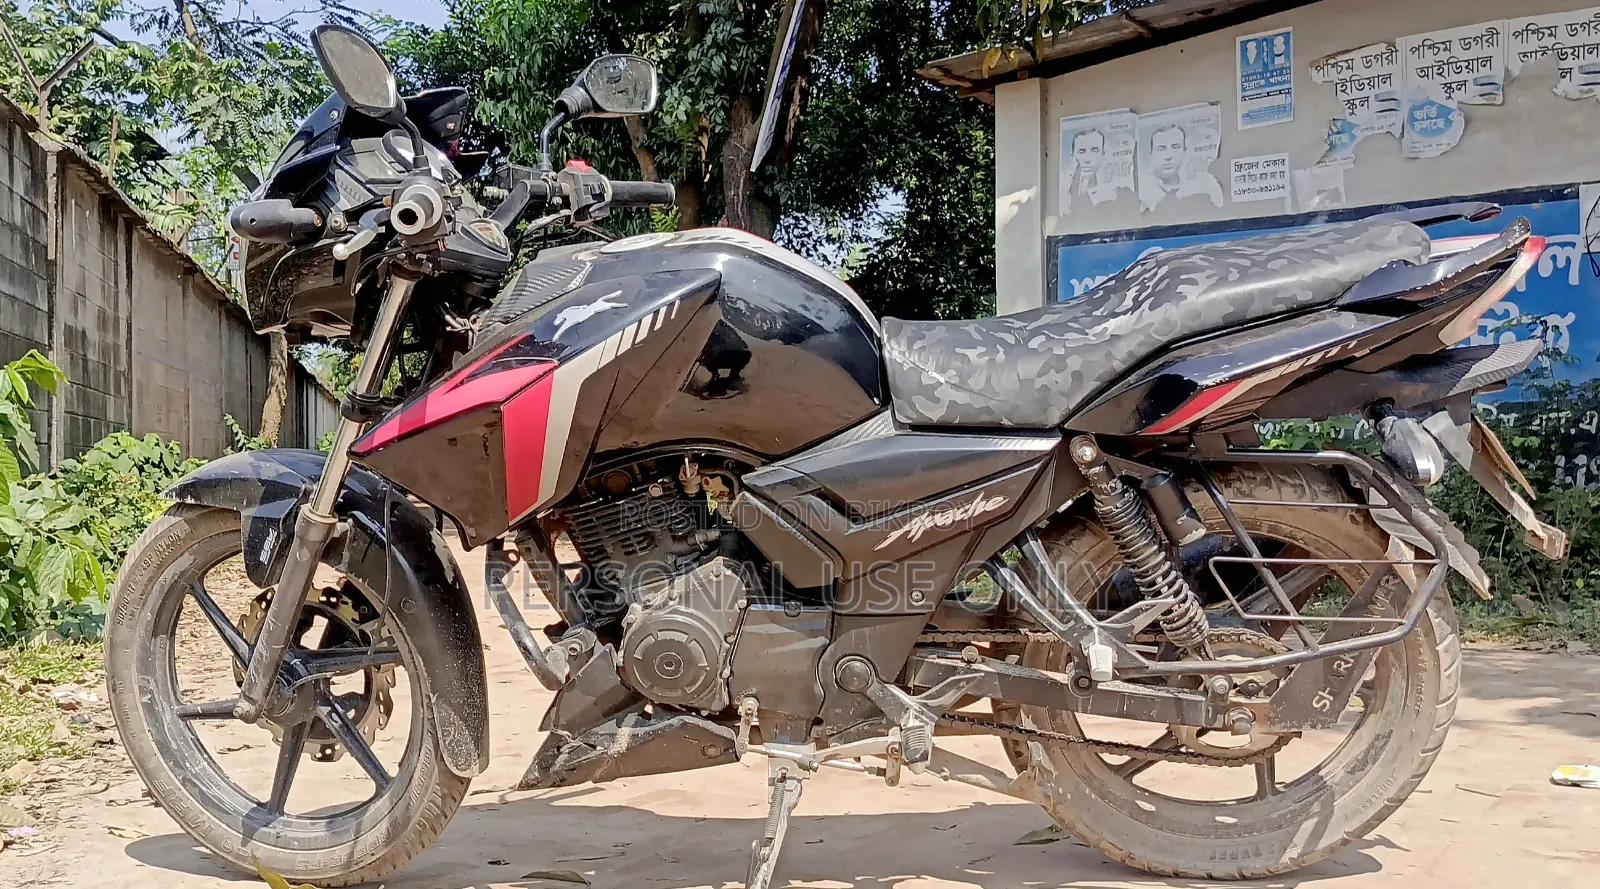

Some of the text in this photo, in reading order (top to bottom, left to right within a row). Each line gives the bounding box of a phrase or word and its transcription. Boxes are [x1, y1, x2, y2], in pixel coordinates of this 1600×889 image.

[1409, 27, 1501, 60] পশ্চিম ডগরী
[1512, 22, 1559, 44] পশ্চিম
[1314, 56, 1355, 78] পশ্চিম
[1360, 46, 1400, 69] ডগরী
[1415, 55, 1494, 80] আইডিয়াল
[1439, 79, 1469, 101] স্কুল
[1342, 96, 1371, 117] স্কুল
[872, 491, 1010, 551] Apache
[152, 779, 215, 839] MRF
